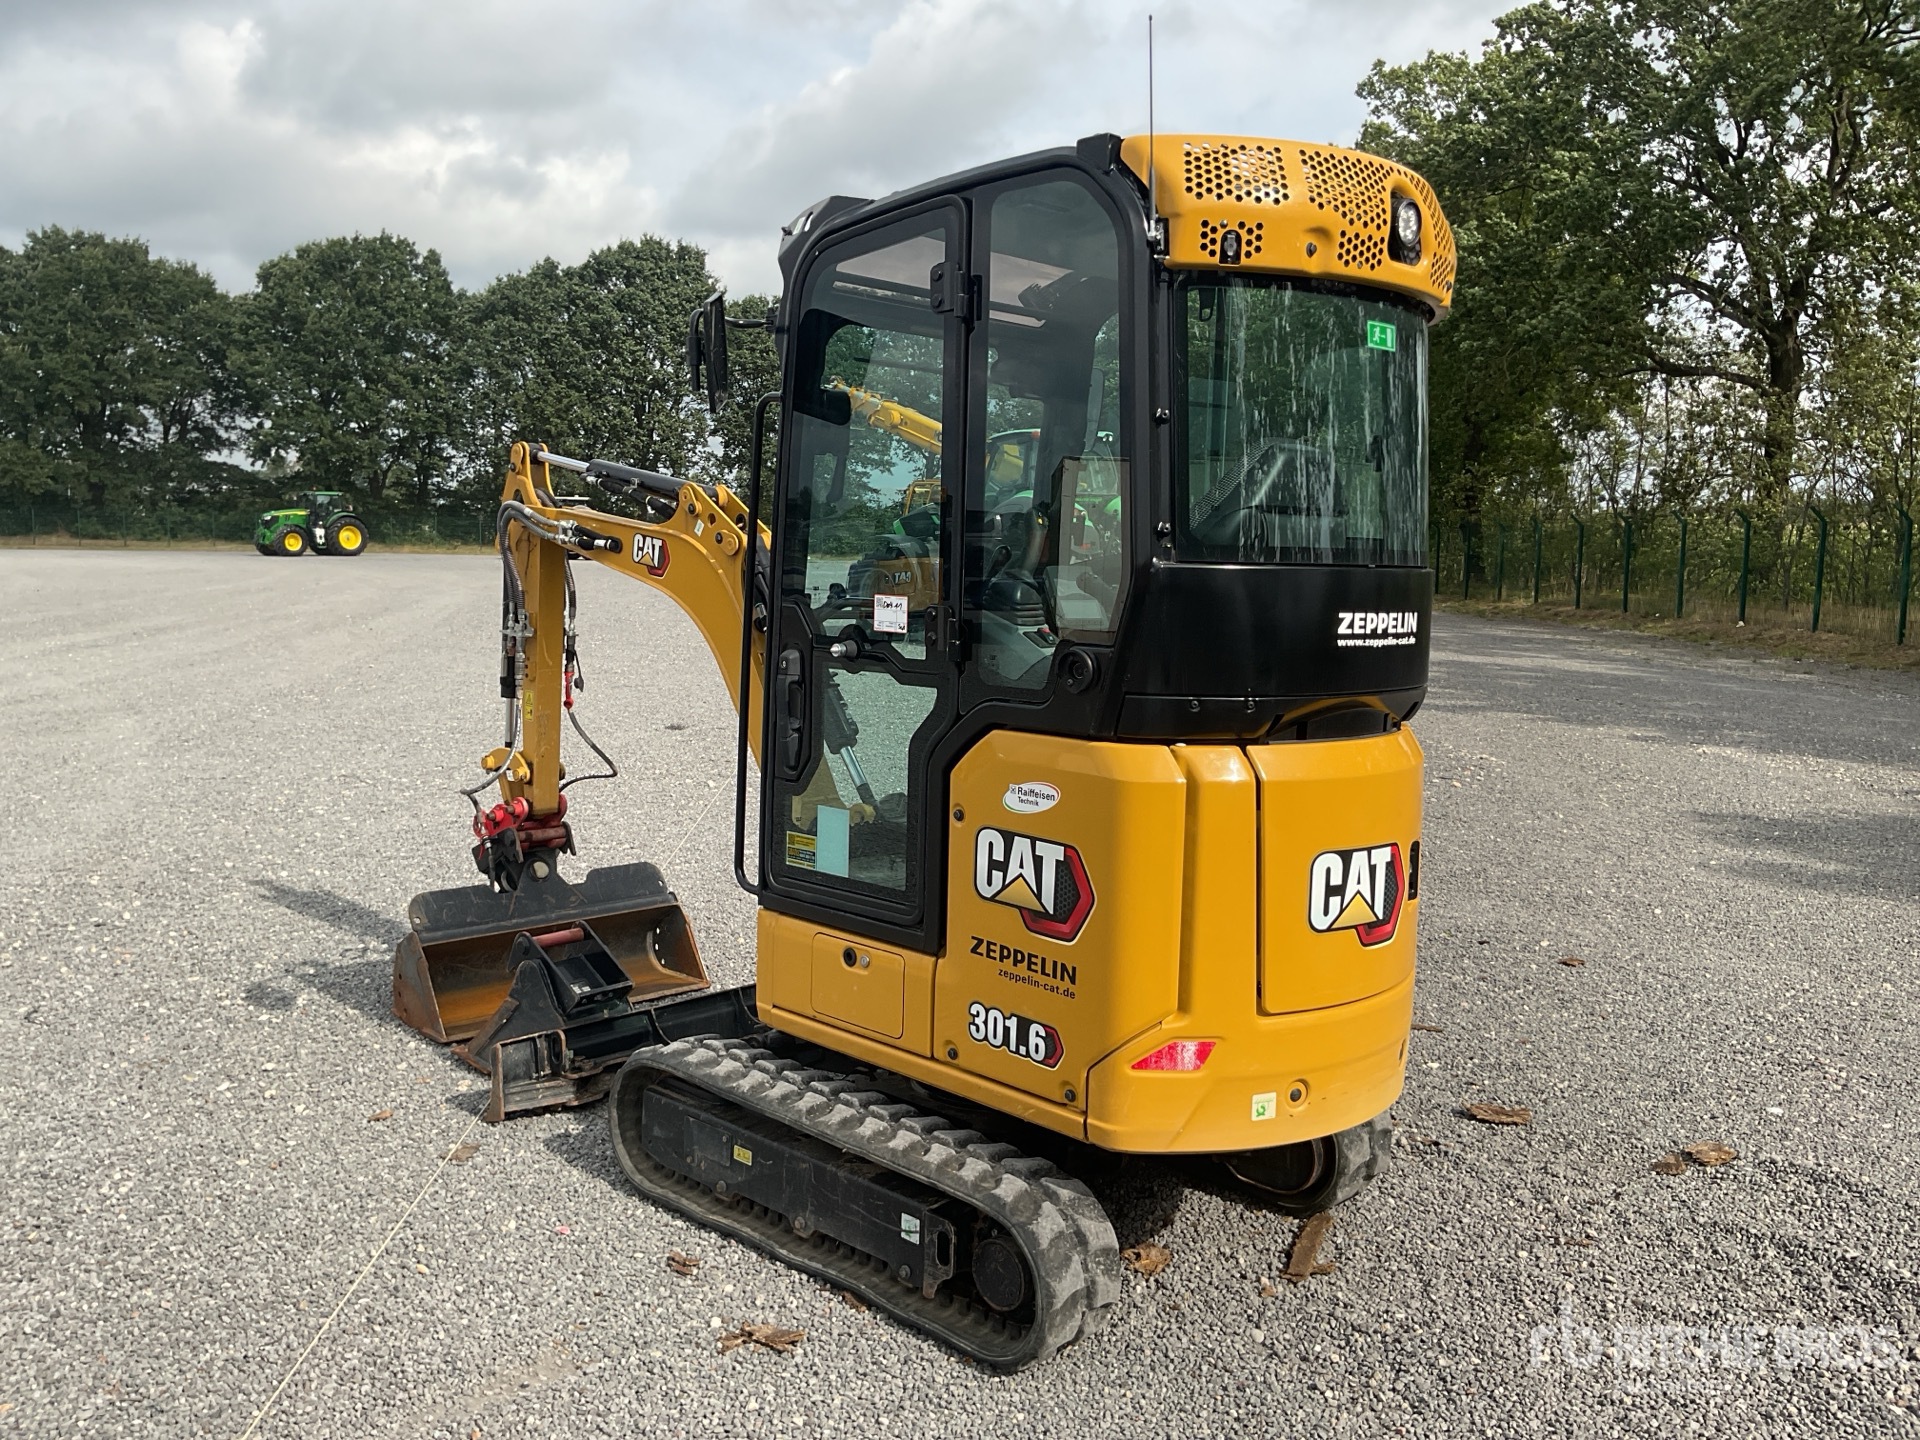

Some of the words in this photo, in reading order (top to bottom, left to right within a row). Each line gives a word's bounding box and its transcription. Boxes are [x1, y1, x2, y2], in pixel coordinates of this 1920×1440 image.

[633, 533, 662, 567] CAT
[1337, 612, 1418, 634] ZEPPELIN
[1337, 636, 1416, 648] www.zeppelin-cat.de
[1017, 786, 1055, 801] Raiffeisen
[1018, 796, 1039, 806] Technik
[976, 828, 1064, 916] CAT
[1310, 846, 1392, 931] CAT
[970, 936, 1077, 986] ZEPPELIN
[998, 969, 1076, 1000] zeppelin-cat.de
[969, 1003, 1047, 1062] 301.6
